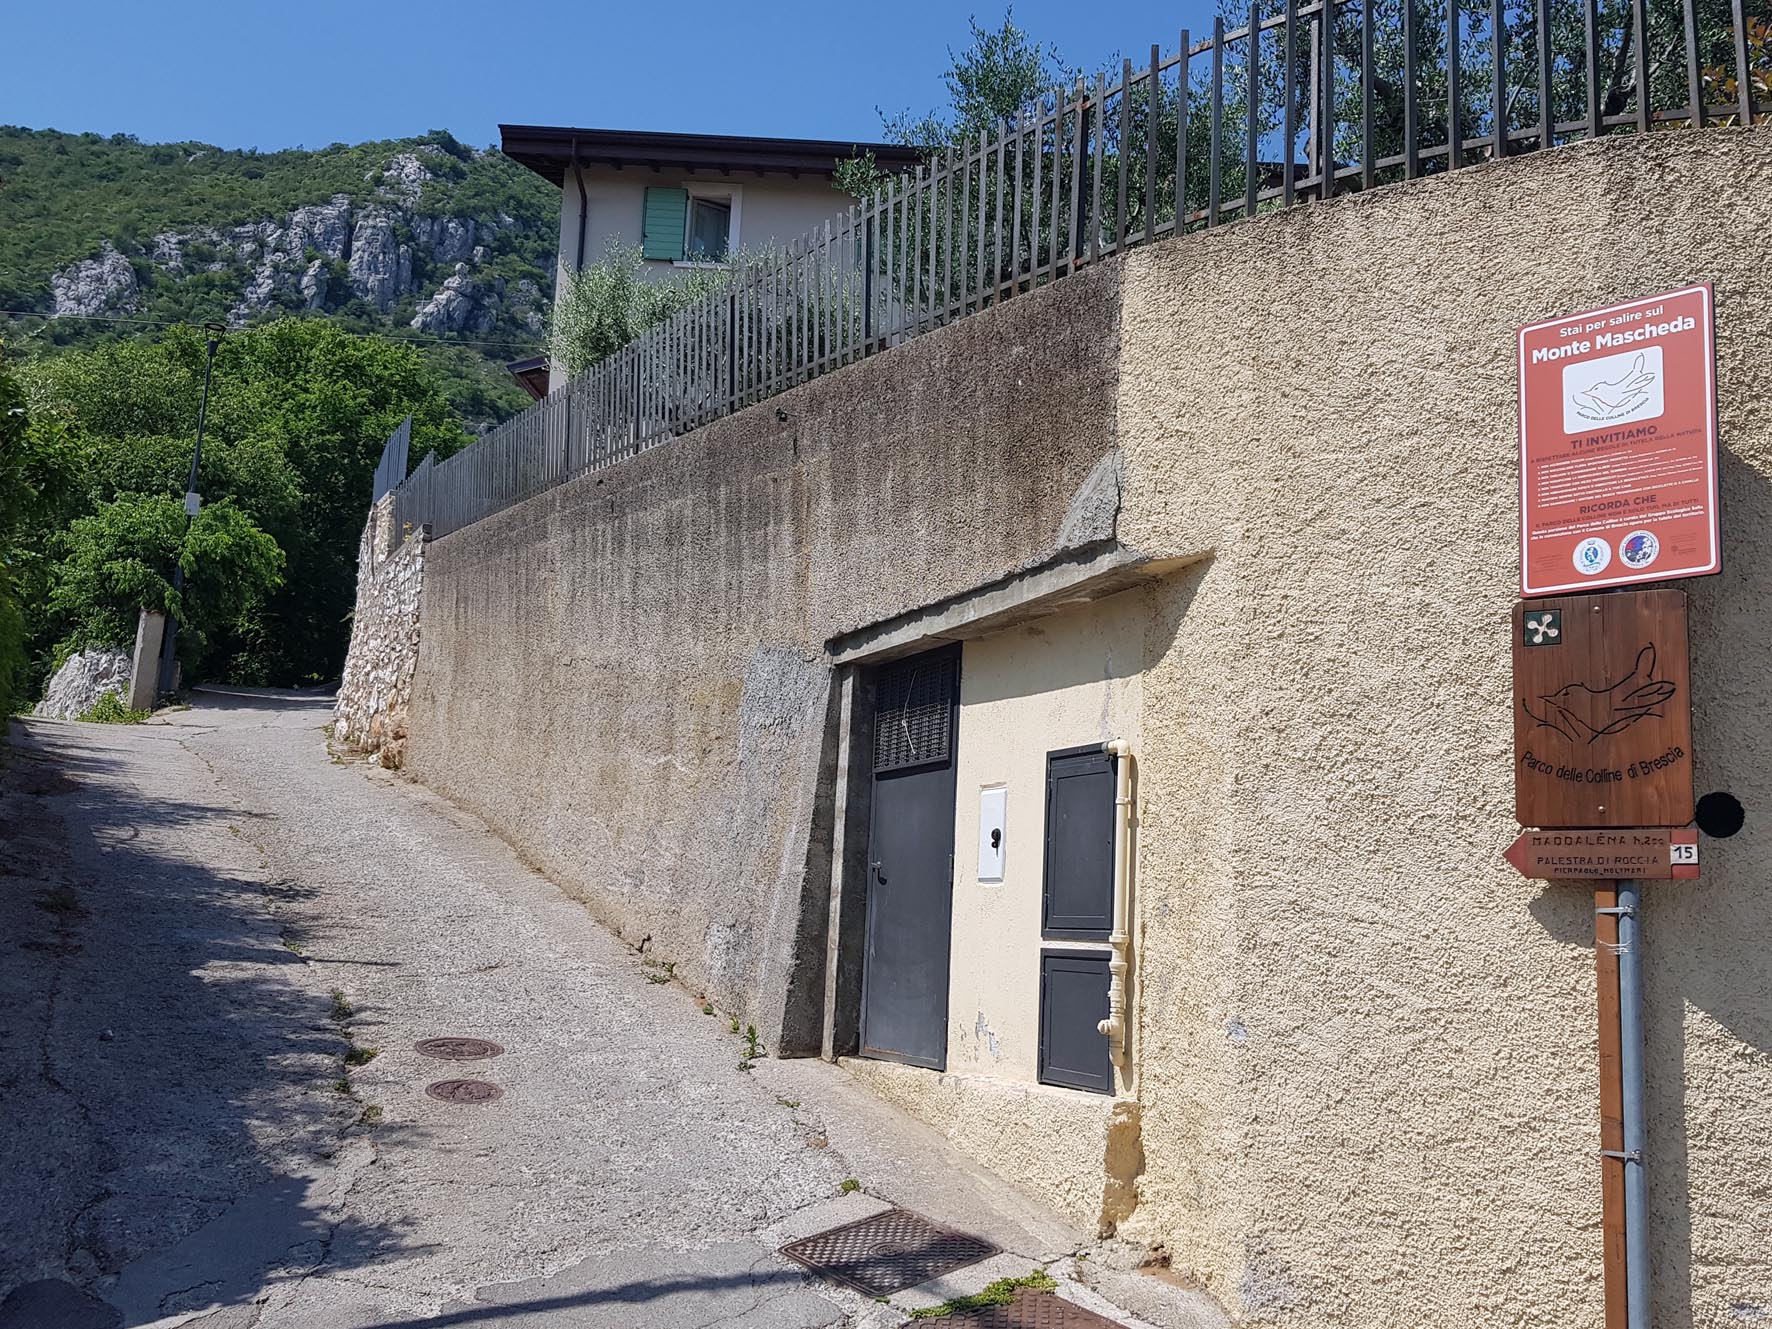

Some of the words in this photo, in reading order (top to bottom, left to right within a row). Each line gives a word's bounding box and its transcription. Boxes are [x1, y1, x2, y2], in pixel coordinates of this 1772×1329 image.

[1560, 326, 1583, 338] Stai
[1586, 321, 1606, 334] per
[1610, 311, 1642, 326] salire
[1645, 305, 1664, 317] sul
[1532, 340, 1591, 364] Monte
[1596, 316, 1696, 350] Mascheda
[1576, 411, 1590, 419] PARCO
[1631, 397, 1649, 412] BRESCIA
[1570, 439, 1581, 449] TI
[1586, 425, 1657, 446] INVITIAMO
[1579, 499, 1629, 513] RICORDA
[1633, 495, 1656, 505] CHE
[1520, 750, 1553, 775] Parco
[1556, 765, 1583, 782] delle
[1586, 768, 1622, 783] Colline
[1628, 764, 1638, 778] di
[1642, 746, 1685, 776] Brescia
[1538, 856, 1593, 865] PALESTRA
[1596, 856, 1609, 865] DI
[1615, 856, 1658, 865] ROCCIA
[1674, 846, 1693, 859] 15
